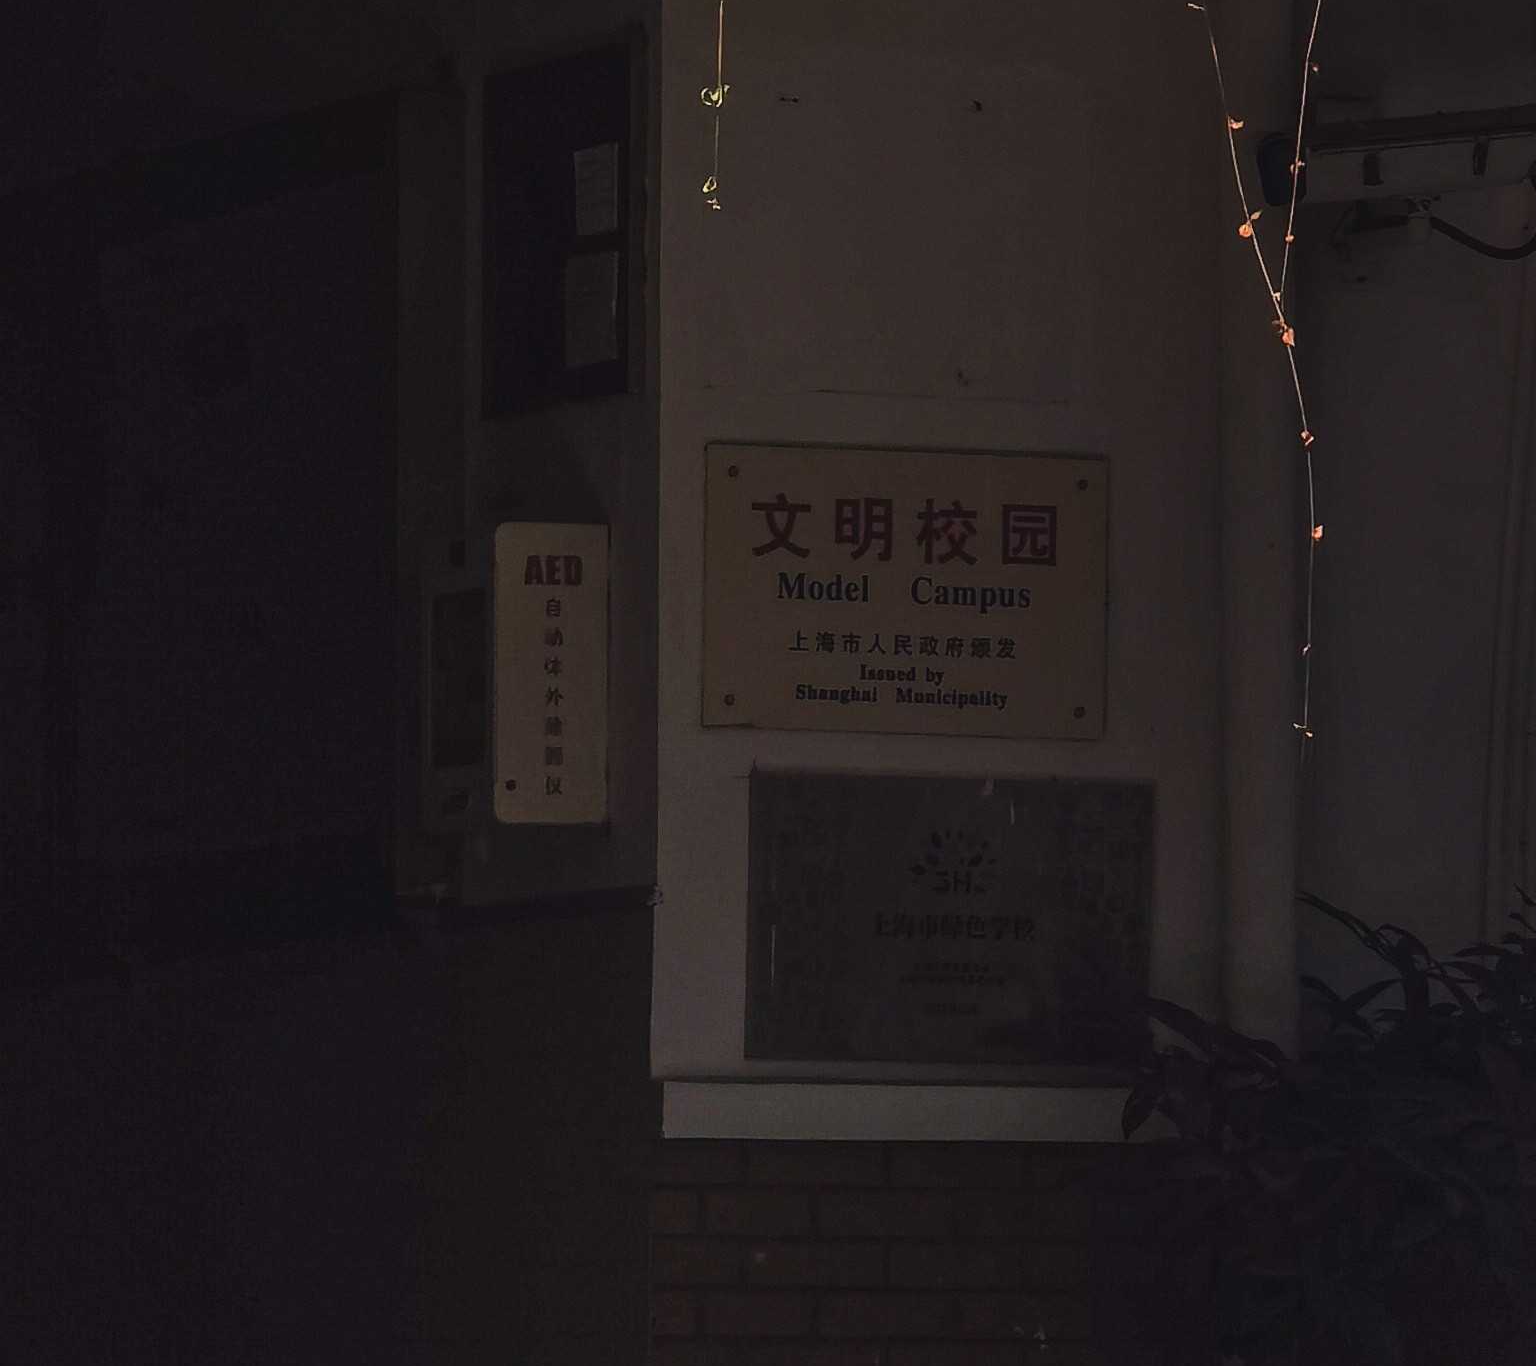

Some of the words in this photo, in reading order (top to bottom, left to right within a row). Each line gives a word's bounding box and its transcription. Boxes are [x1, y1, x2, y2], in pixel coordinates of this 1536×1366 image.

[752, 492, 1058, 567] 文明校园
[524, 554, 583, 586] AED
[776, 571, 870, 603] Model
[911, 576, 1032, 614] Campus
[788, 630, 1017, 660] 上海市人民政府颁发
[859, 664, 916, 682] Issued
[926, 666, 945, 686] by
[795, 684, 878, 704] Shanghai
[896, 687, 1009, 710] Municipality
